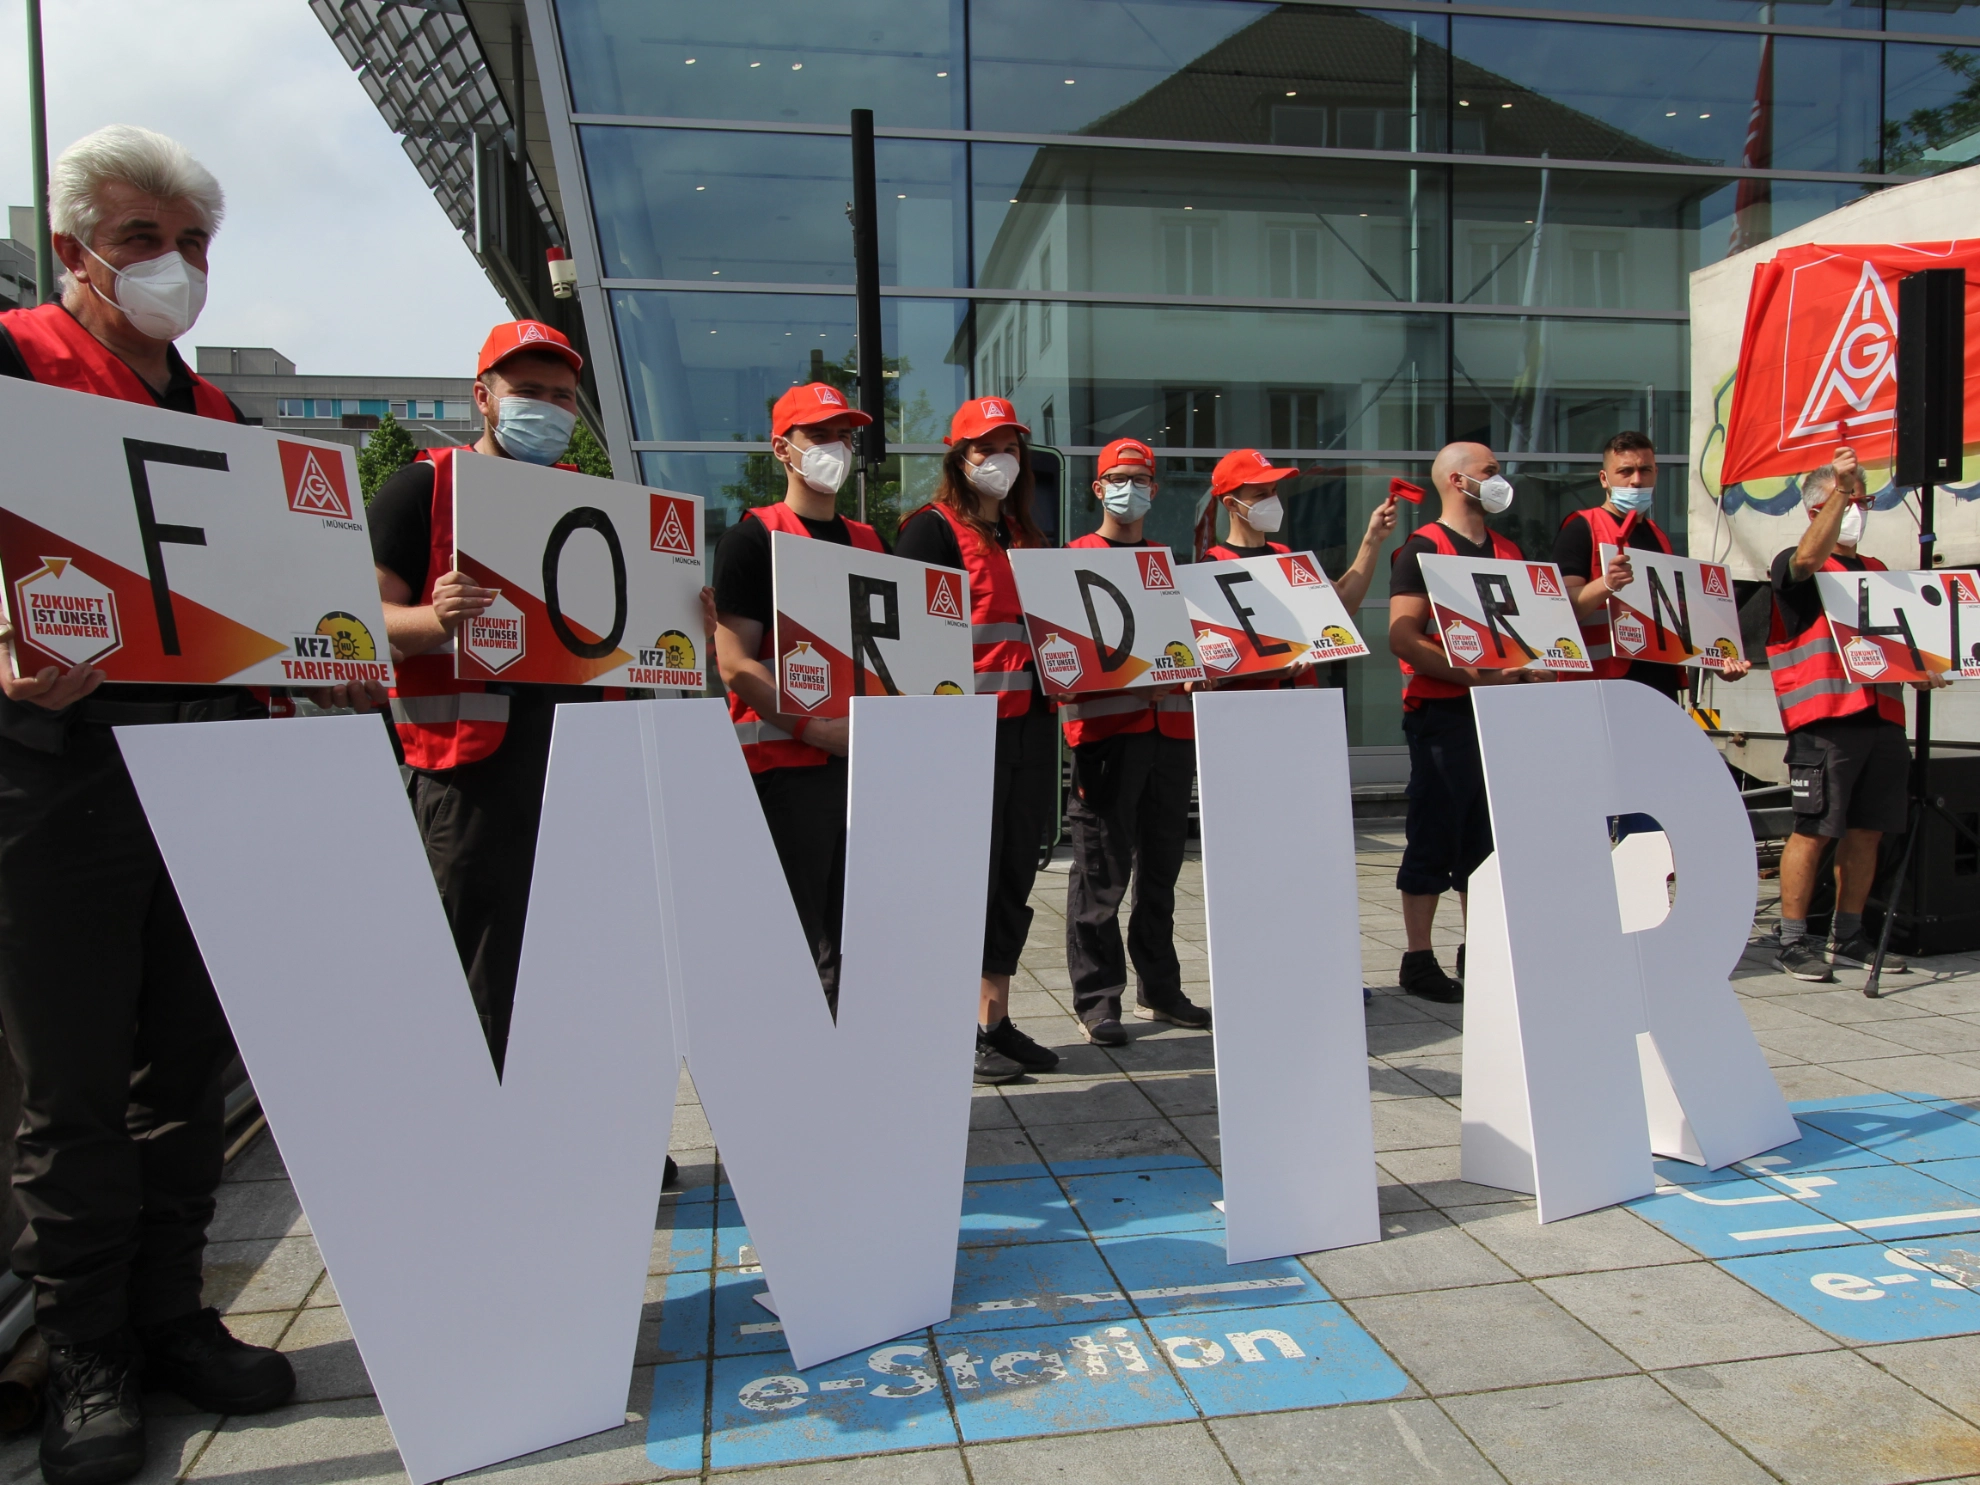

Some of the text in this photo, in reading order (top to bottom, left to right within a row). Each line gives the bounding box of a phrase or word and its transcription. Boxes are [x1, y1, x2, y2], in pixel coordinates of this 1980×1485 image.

[298, 460, 343, 512] IGM
[326, 520, 363, 531] MÜNCHEN
[657, 510, 688, 550] IGM
[123, 437, 230, 656] F
[675, 556, 701, 566] MÜNCHEN
[30, 593, 104, 612] ZUKUNFT
[32, 609, 108, 626] IST UNSER
[1214, 571, 1291, 657] E
[1471, 573, 1538, 659] R
[1646, 566, 1693, 655] N
[472, 615, 518, 630] ZUKUNFT
[1074, 569, 1135, 672] D
[34, 622, 109, 638] HANDWERK
[472, 627, 518, 641] IST UNSER
[848, 573, 900, 697] R
[294, 637, 331, 658] KFZ
[472, 637, 518, 650] HANDWERK
[1200, 642, 1229, 651] ZUKUNFT
[1313, 638, 1333, 649] KFZ
[639, 650, 663, 666] KFZ
[1045, 651, 1073, 660] ZUKUNFT
[1310, 644, 1366, 660] TARIFRUNDE
[1546, 649, 1563, 658] KFZ
[1705, 647, 1720, 657] KFZ
[789, 663, 824, 676] ZUKUNFT
[1057, 658, 1076, 666] UNSER
[1155, 657, 1173, 669] KFZ
[1542, 659, 1589, 669] TARIFRUNDE
[1700, 656, 1725, 668] TARIFR
[281, 660, 390, 681] TARIFRUNDE
[628, 668, 702, 686] TARIFRUNDE
[1150, 667, 1203, 682] TARIFRUNDE
[789, 673, 825, 685] IST UNSER
[790, 681, 825, 692] HANDWERK
[738, 1326, 1307, 1412] e-Station
